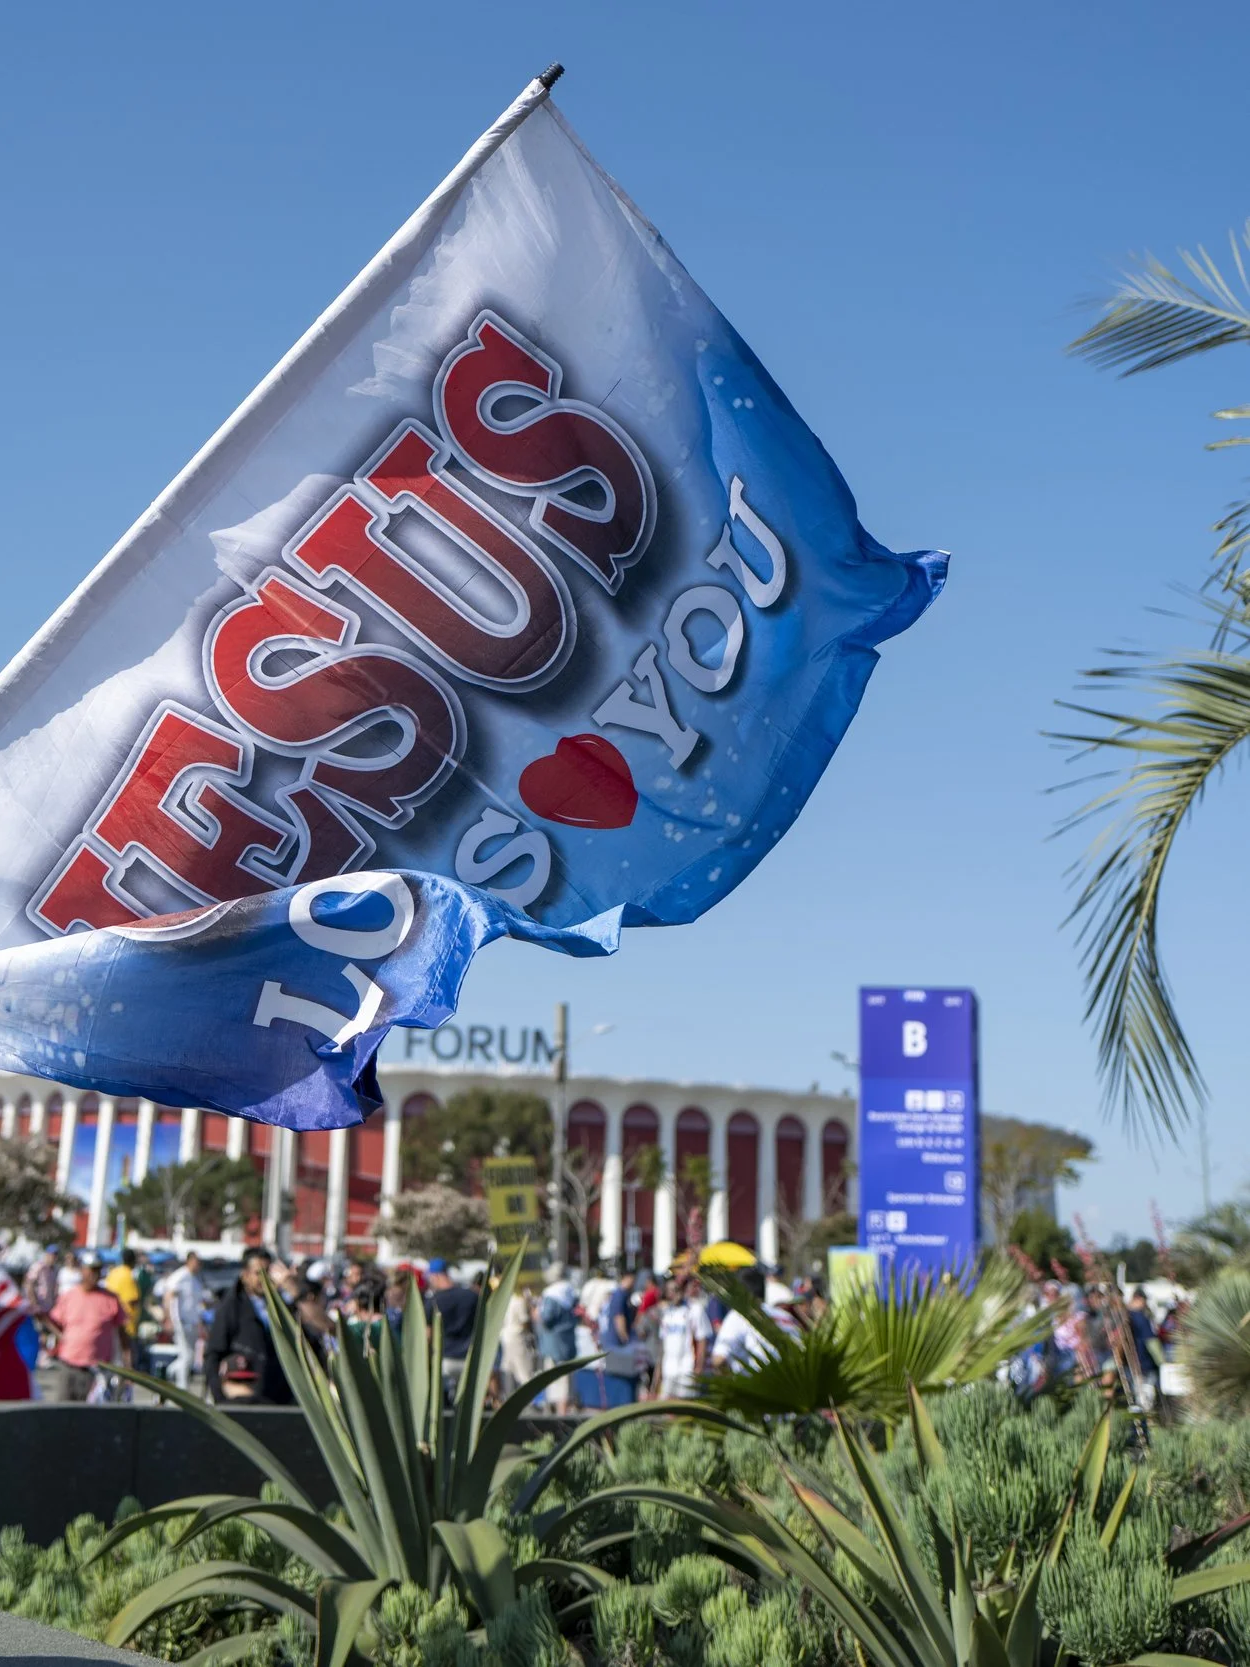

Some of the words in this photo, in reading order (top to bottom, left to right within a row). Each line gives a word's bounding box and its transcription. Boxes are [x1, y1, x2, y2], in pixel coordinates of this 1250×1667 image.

[591, 474, 787, 772] YOU
[405, 1024, 563, 1064] FORUM
[902, 1019, 928, 1058] B
